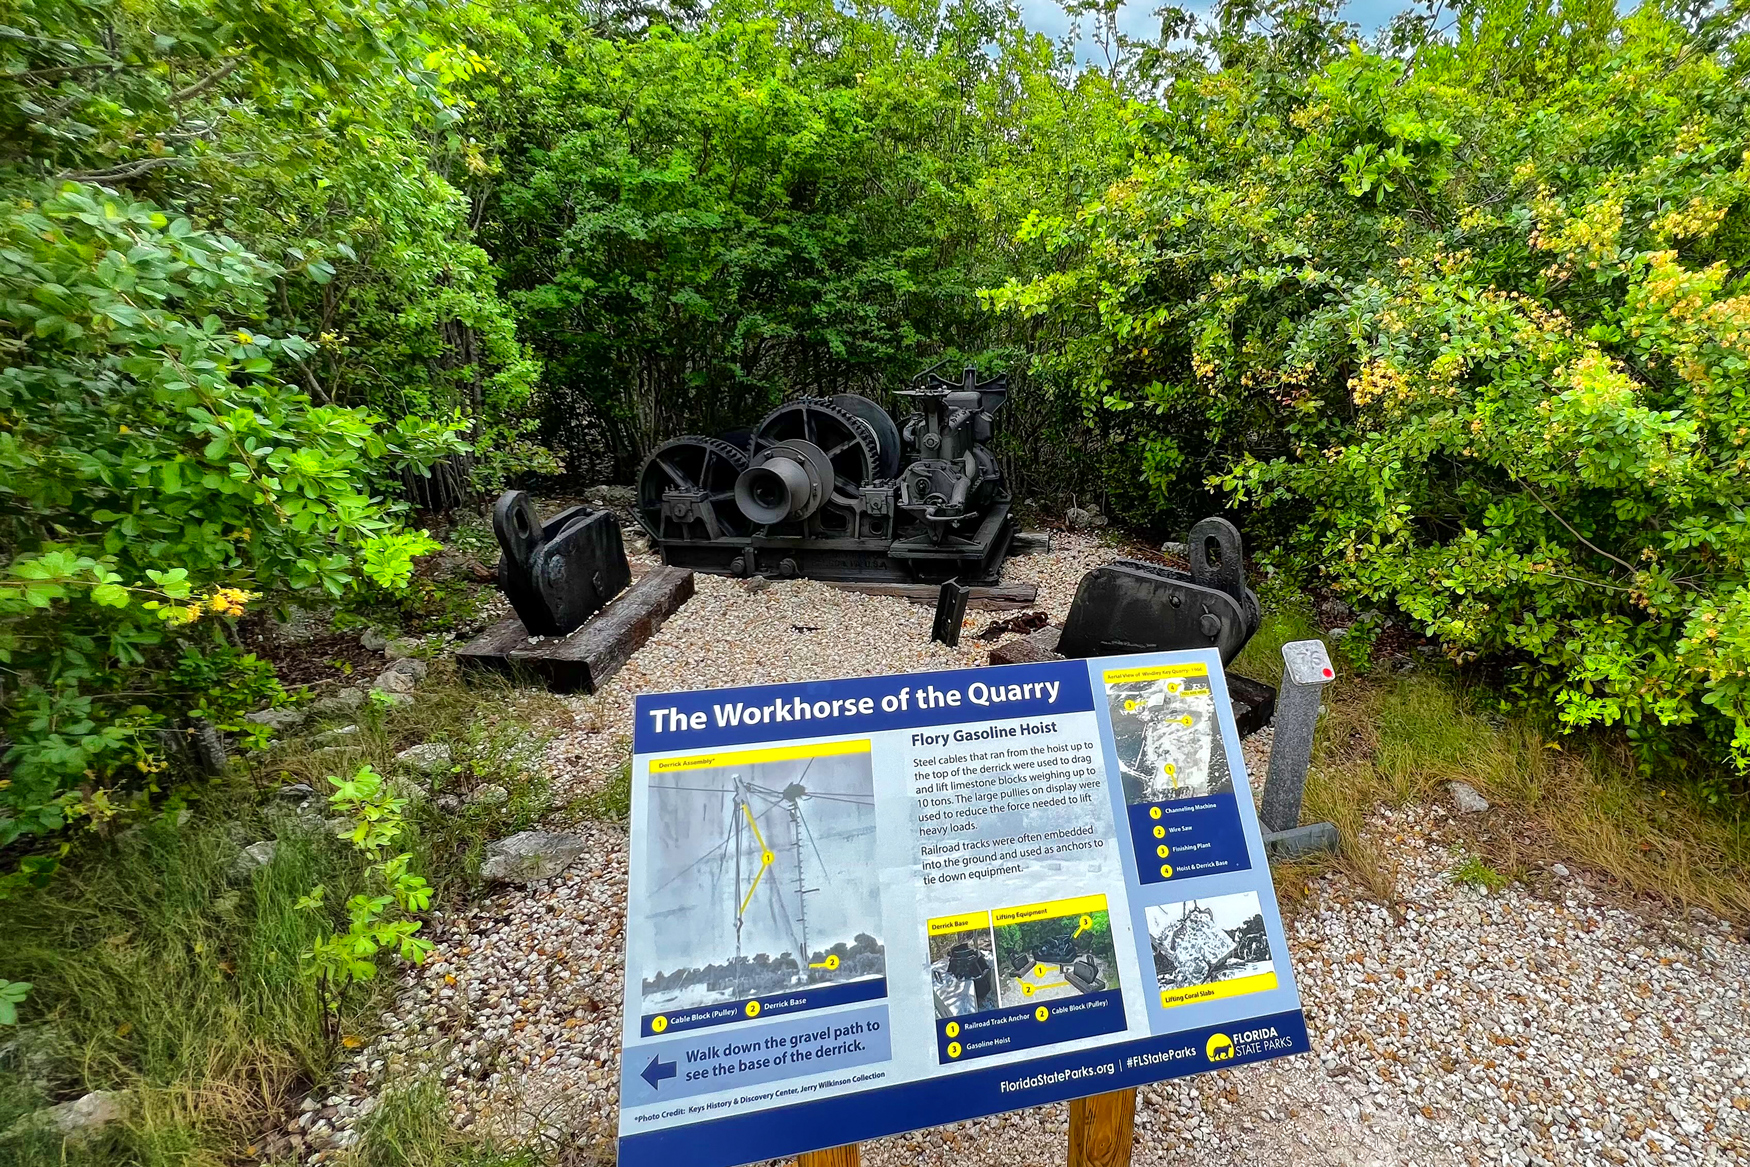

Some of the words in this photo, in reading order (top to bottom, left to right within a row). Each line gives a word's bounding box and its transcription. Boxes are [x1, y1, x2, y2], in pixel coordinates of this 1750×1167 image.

[649, 707, 707, 732] The
[713, 696, 874, 727] Workhorse
[881, 687, 909, 712] of
[915, 685, 961, 708] the
[968, 680, 1059, 706] Quarry
[911, 732, 949, 747] Flory
[953, 726, 1016, 742] Gasoline
[1020, 721, 1057, 735] Hoist
[913, 756, 936, 767] Steel
[938, 754, 967, 764] cables
[969, 752, 988, 761] that
[1006, 748, 1028, 757] from
[1030, 746, 1045, 755] the
[1046, 744, 1068, 753] hoist
[1070, 743, 1082, 752] up
[914, 771, 930, 780] the
[932, 770, 948, 780] top
[950, 766, 960, 776] of
[962, 766, 977, 775] the
[979, 762, 1011, 773] derrick
[1012, 761, 1035, 770] were
[1036, 756, 1058, 767] used
[1071, 754, 1091, 764] drag
[915, 783, 933, 794] and
[935, 781, 948, 792] lift
[950, 778, 996, 790] limestone
[997, 774, 1027, 785] blocks
[1028, 770, 1070, 782] weighing
[1072, 769, 1084, 778] up
[1086, 767, 1096, 775] to
[917, 798, 928, 808] 10
[930, 797, 954, 806] tons.
[954, 794, 972, 803] The
[974, 792, 998, 802] large
[1000, 787, 1030, 800] pullies
[1045, 782, 1076, 794] display
[1078, 780, 1100, 789] were
[918, 810, 940, 822] used
[943, 810, 953, 819] to
[955, 806, 987, 817] reduce
[989, 804, 1005, 813] the
[1006, 801, 1030, 811] force
[1032, 795, 1066, 808] needed
[1068, 796, 1078, 804] to
[1079, 792, 1092, 802] lift
[919, 826, 947, 836] heavy
[949, 820, 977, 832] loads.
[921, 841, 960, 856] Railroad
[962, 838, 990, 850] tracks
[991, 837, 1015, 846] were
[1017, 832, 1042, 843] often
[1044, 824, 1093, 840] embedded
[922, 860, 941, 870] into
[943, 857, 960, 867] the
[962, 851, 997, 867] ground
[999, 848, 1017, 860] and
[1019, 845, 1042, 857] used
[1044, 846, 1054, 854] as
[1056, 841, 1092, 852] anchors
[1093, 839, 1103, 847] to
[923, 874, 936, 885] tie
[938, 872, 966, 883] down
[968, 864, 1023, 880] equipment.
[931, 921, 953, 930] Derrick
[1015, 908, 1047, 918] Equipment
[670, 1015, 690, 1024] Cable
[691, 1011, 710, 1021] Block
[711, 1007, 737, 1018] (Pulley)
[764, 1000, 788, 1010] Derrick
[964, 1019, 990, 1030] Railroad
[990, 1016, 1007, 1025] Track
[1008, 1014, 1029, 1022] Anchor
[1051, 1006, 1068, 1014] Cable
[1069, 1003, 1085, 1011] Block
[1086, 999, 1108, 1009] (Pulley)
[686, 1046, 720, 1063] Walk
[723, 1042, 760, 1056] down
[764, 1036, 787, 1052] the
[789, 1026, 830, 1048] gravel
[834, 1021, 863, 1042] path
[866, 1021, 880, 1031] to
[966, 1040, 993, 1050] Gasoline
[994, 1036, 1010, 1044] Hoist
[1232, 1026, 1278, 1044] FLORIDA
[1235, 1041, 1262, 1056] STATE
[1263, 1036, 1292, 1051] PARKS
[685, 1069, 709, 1081] see
[712, 1062, 735, 1076] the
[738, 1058, 770, 1072] base
[773, 1050, 787, 1065] of
[789, 1049, 812, 1062] the
[815, 1039, 865, 1058] derrick.
[1126, 1046, 1196, 1068] #FLStateParks
[1000, 1063, 1114, 1092] FloridaStateParks.org
[661, 1108, 685, 1118] Credit:
[688, 1105, 705, 1113] Keys
[706, 1100, 732, 1110] History
[740, 1092, 774, 1104] Discovery
[774, 1088, 799, 1097] Center,
[800, 1084, 817, 1092] Jerry
[818, 1078, 851, 1088] Wilkinson
[852, 1072, 885, 1082] Collection
